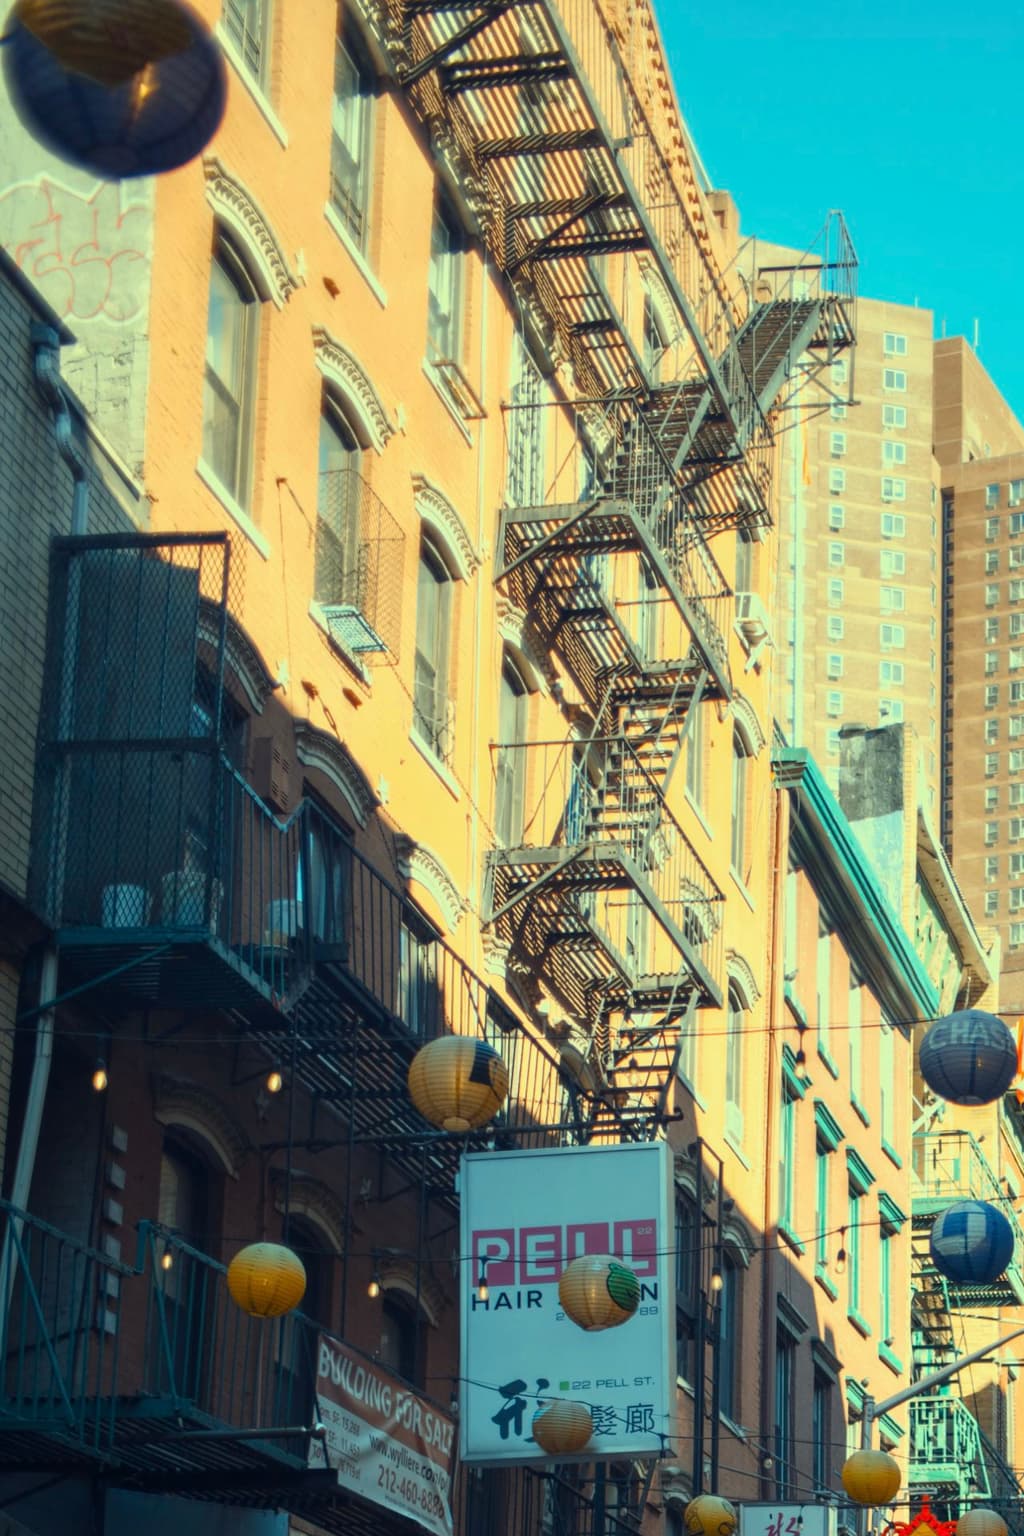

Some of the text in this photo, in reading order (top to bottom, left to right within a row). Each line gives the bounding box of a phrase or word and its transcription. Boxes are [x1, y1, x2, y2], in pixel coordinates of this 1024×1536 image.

[471, 1290, 544, 1311] HAIR
[318, 1342, 392, 1420] BUILDING
[395, 1391, 423, 1437] FOR
[572, 1376, 656, 1390] 22 PELL ST.
